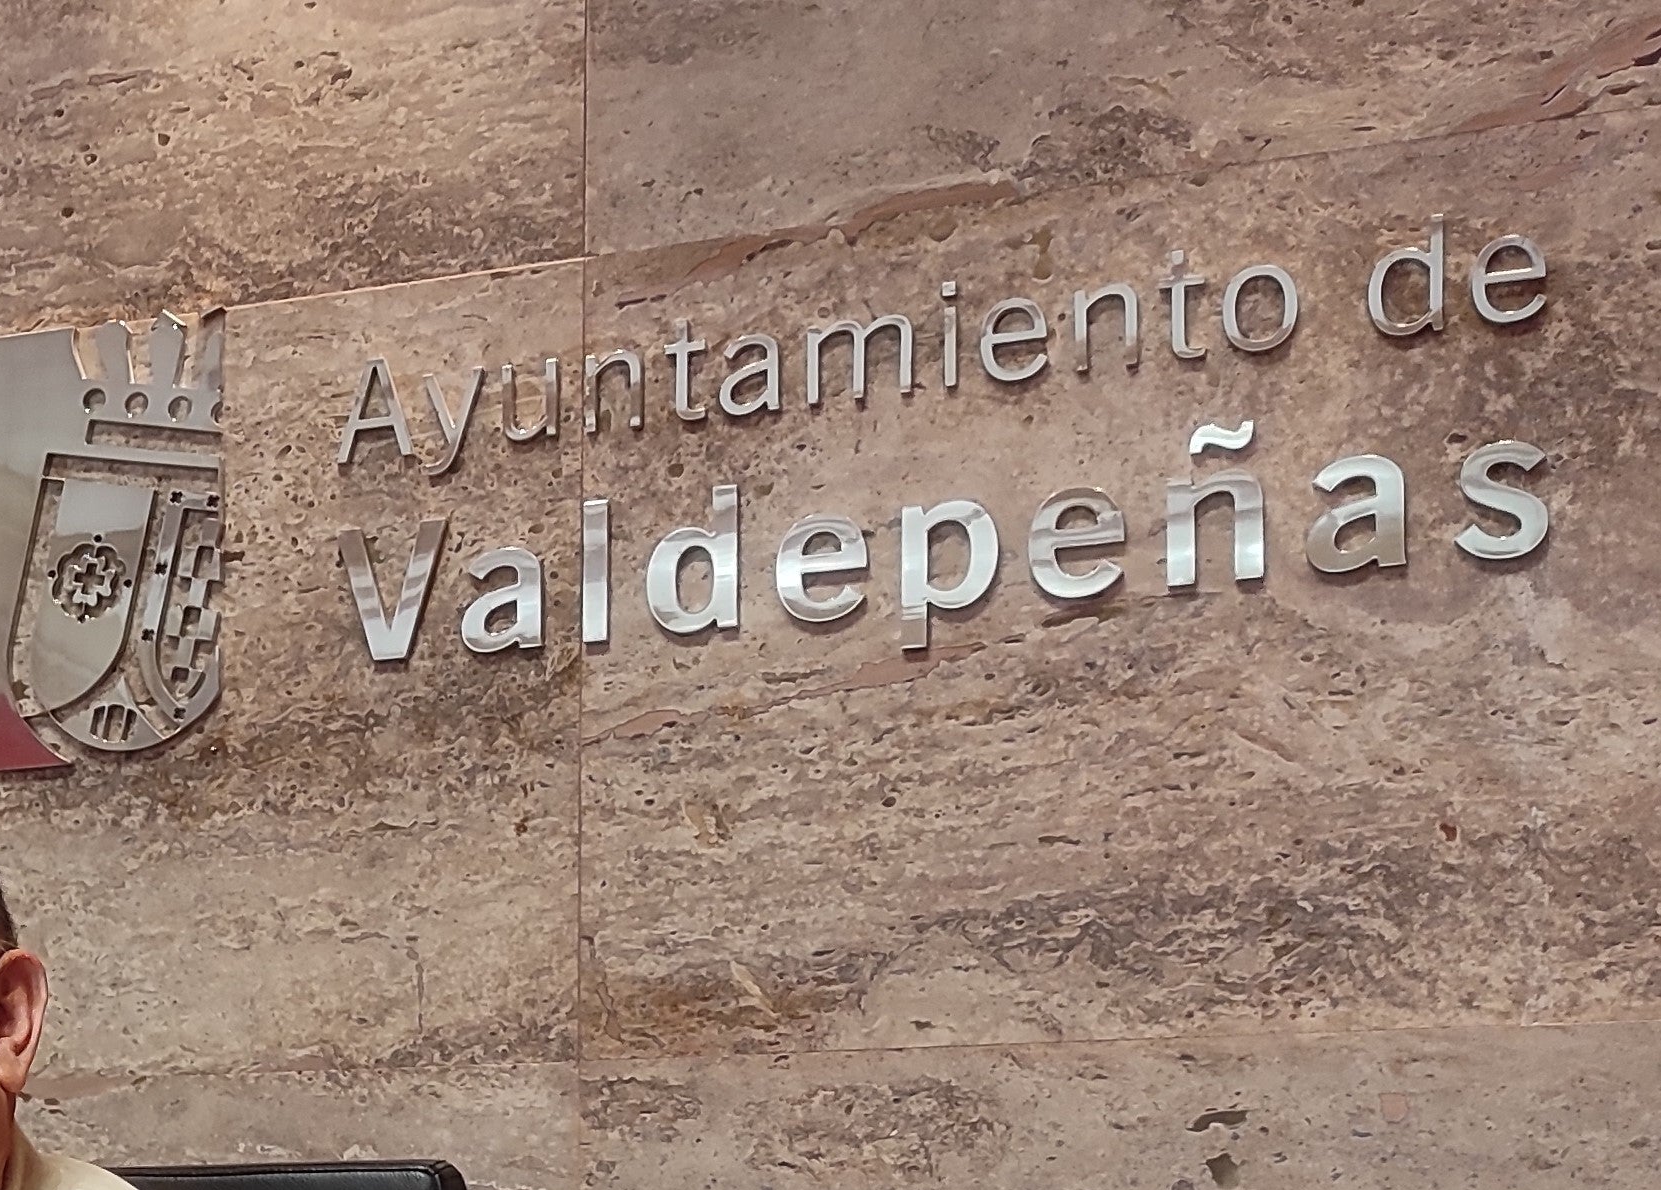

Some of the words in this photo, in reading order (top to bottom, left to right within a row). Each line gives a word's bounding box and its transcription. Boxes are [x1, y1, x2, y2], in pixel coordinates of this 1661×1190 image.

[336, 249, 1300, 476] Ayuntamiento
[1366, 214, 1548, 337] de
[339, 419, 1549, 663] Valdepeñas
